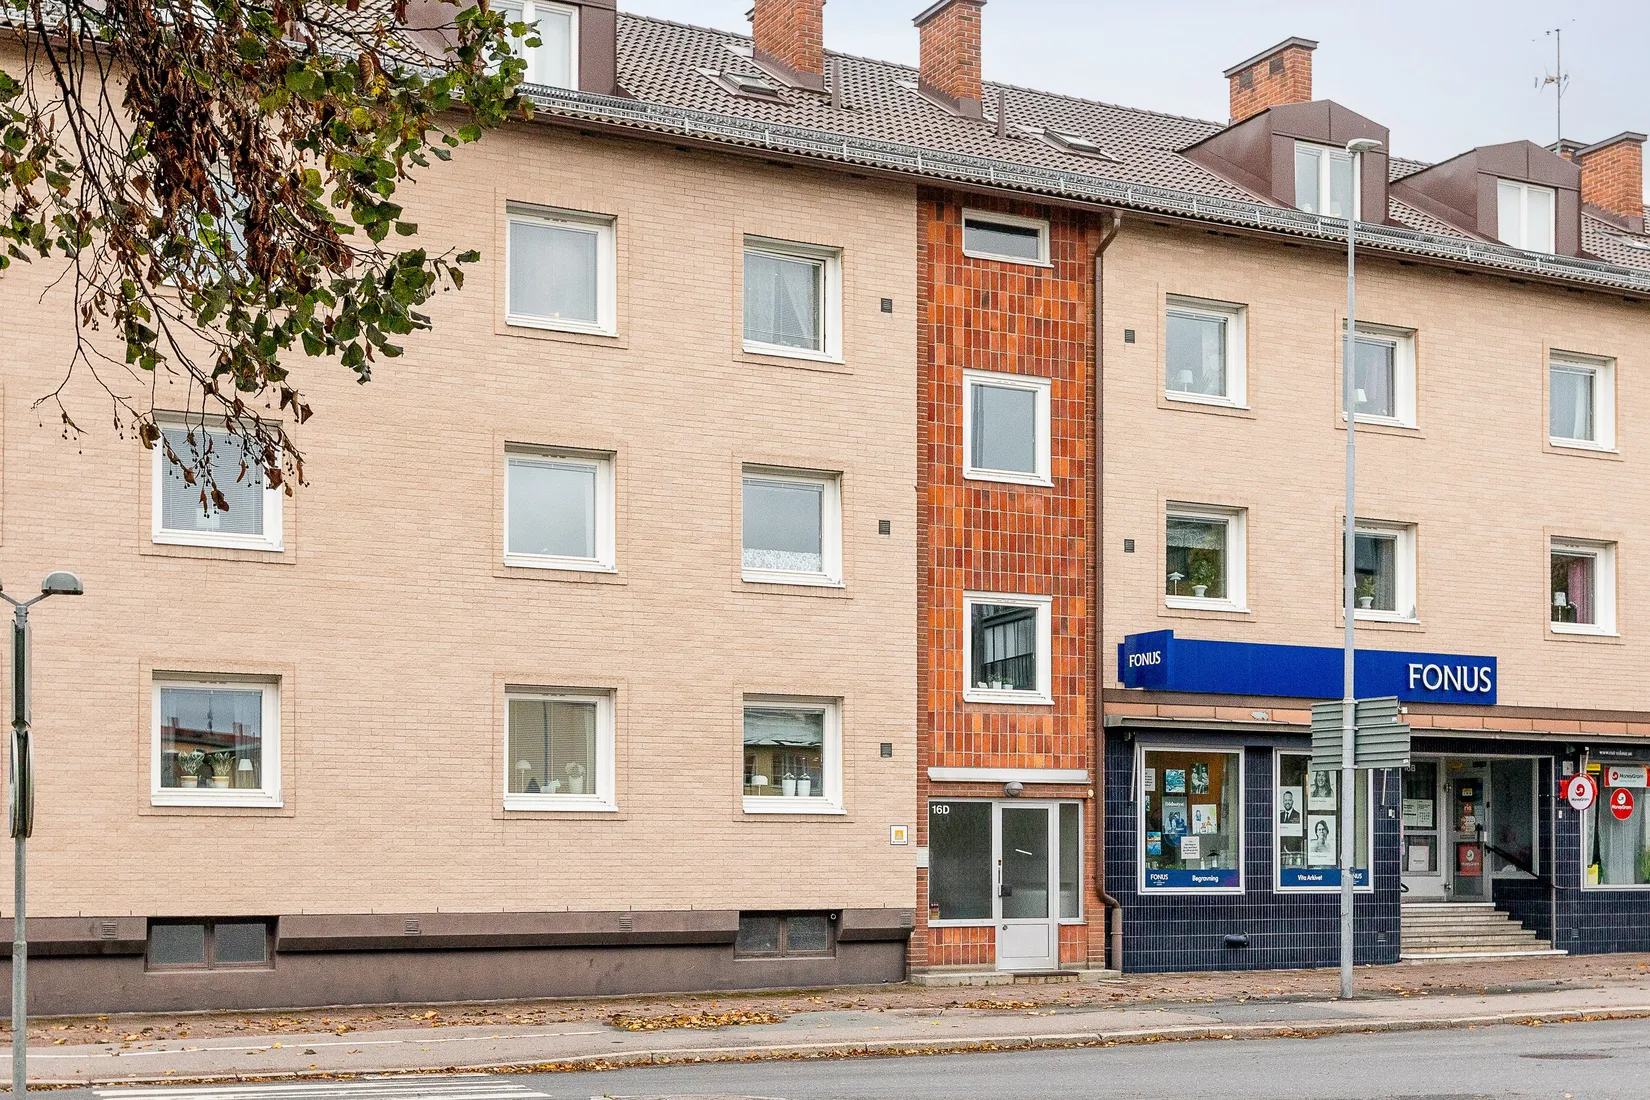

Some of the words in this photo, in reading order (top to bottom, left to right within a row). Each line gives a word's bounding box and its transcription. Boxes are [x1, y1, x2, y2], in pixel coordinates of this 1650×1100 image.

[1129, 651, 1161, 668] FONUS
[1408, 663, 1491, 693] FONUS
[931, 804, 950, 815] 16D
[1150, 873, 1169, 881] FONUS
[1191, 874, 1219, 883] Begravning
